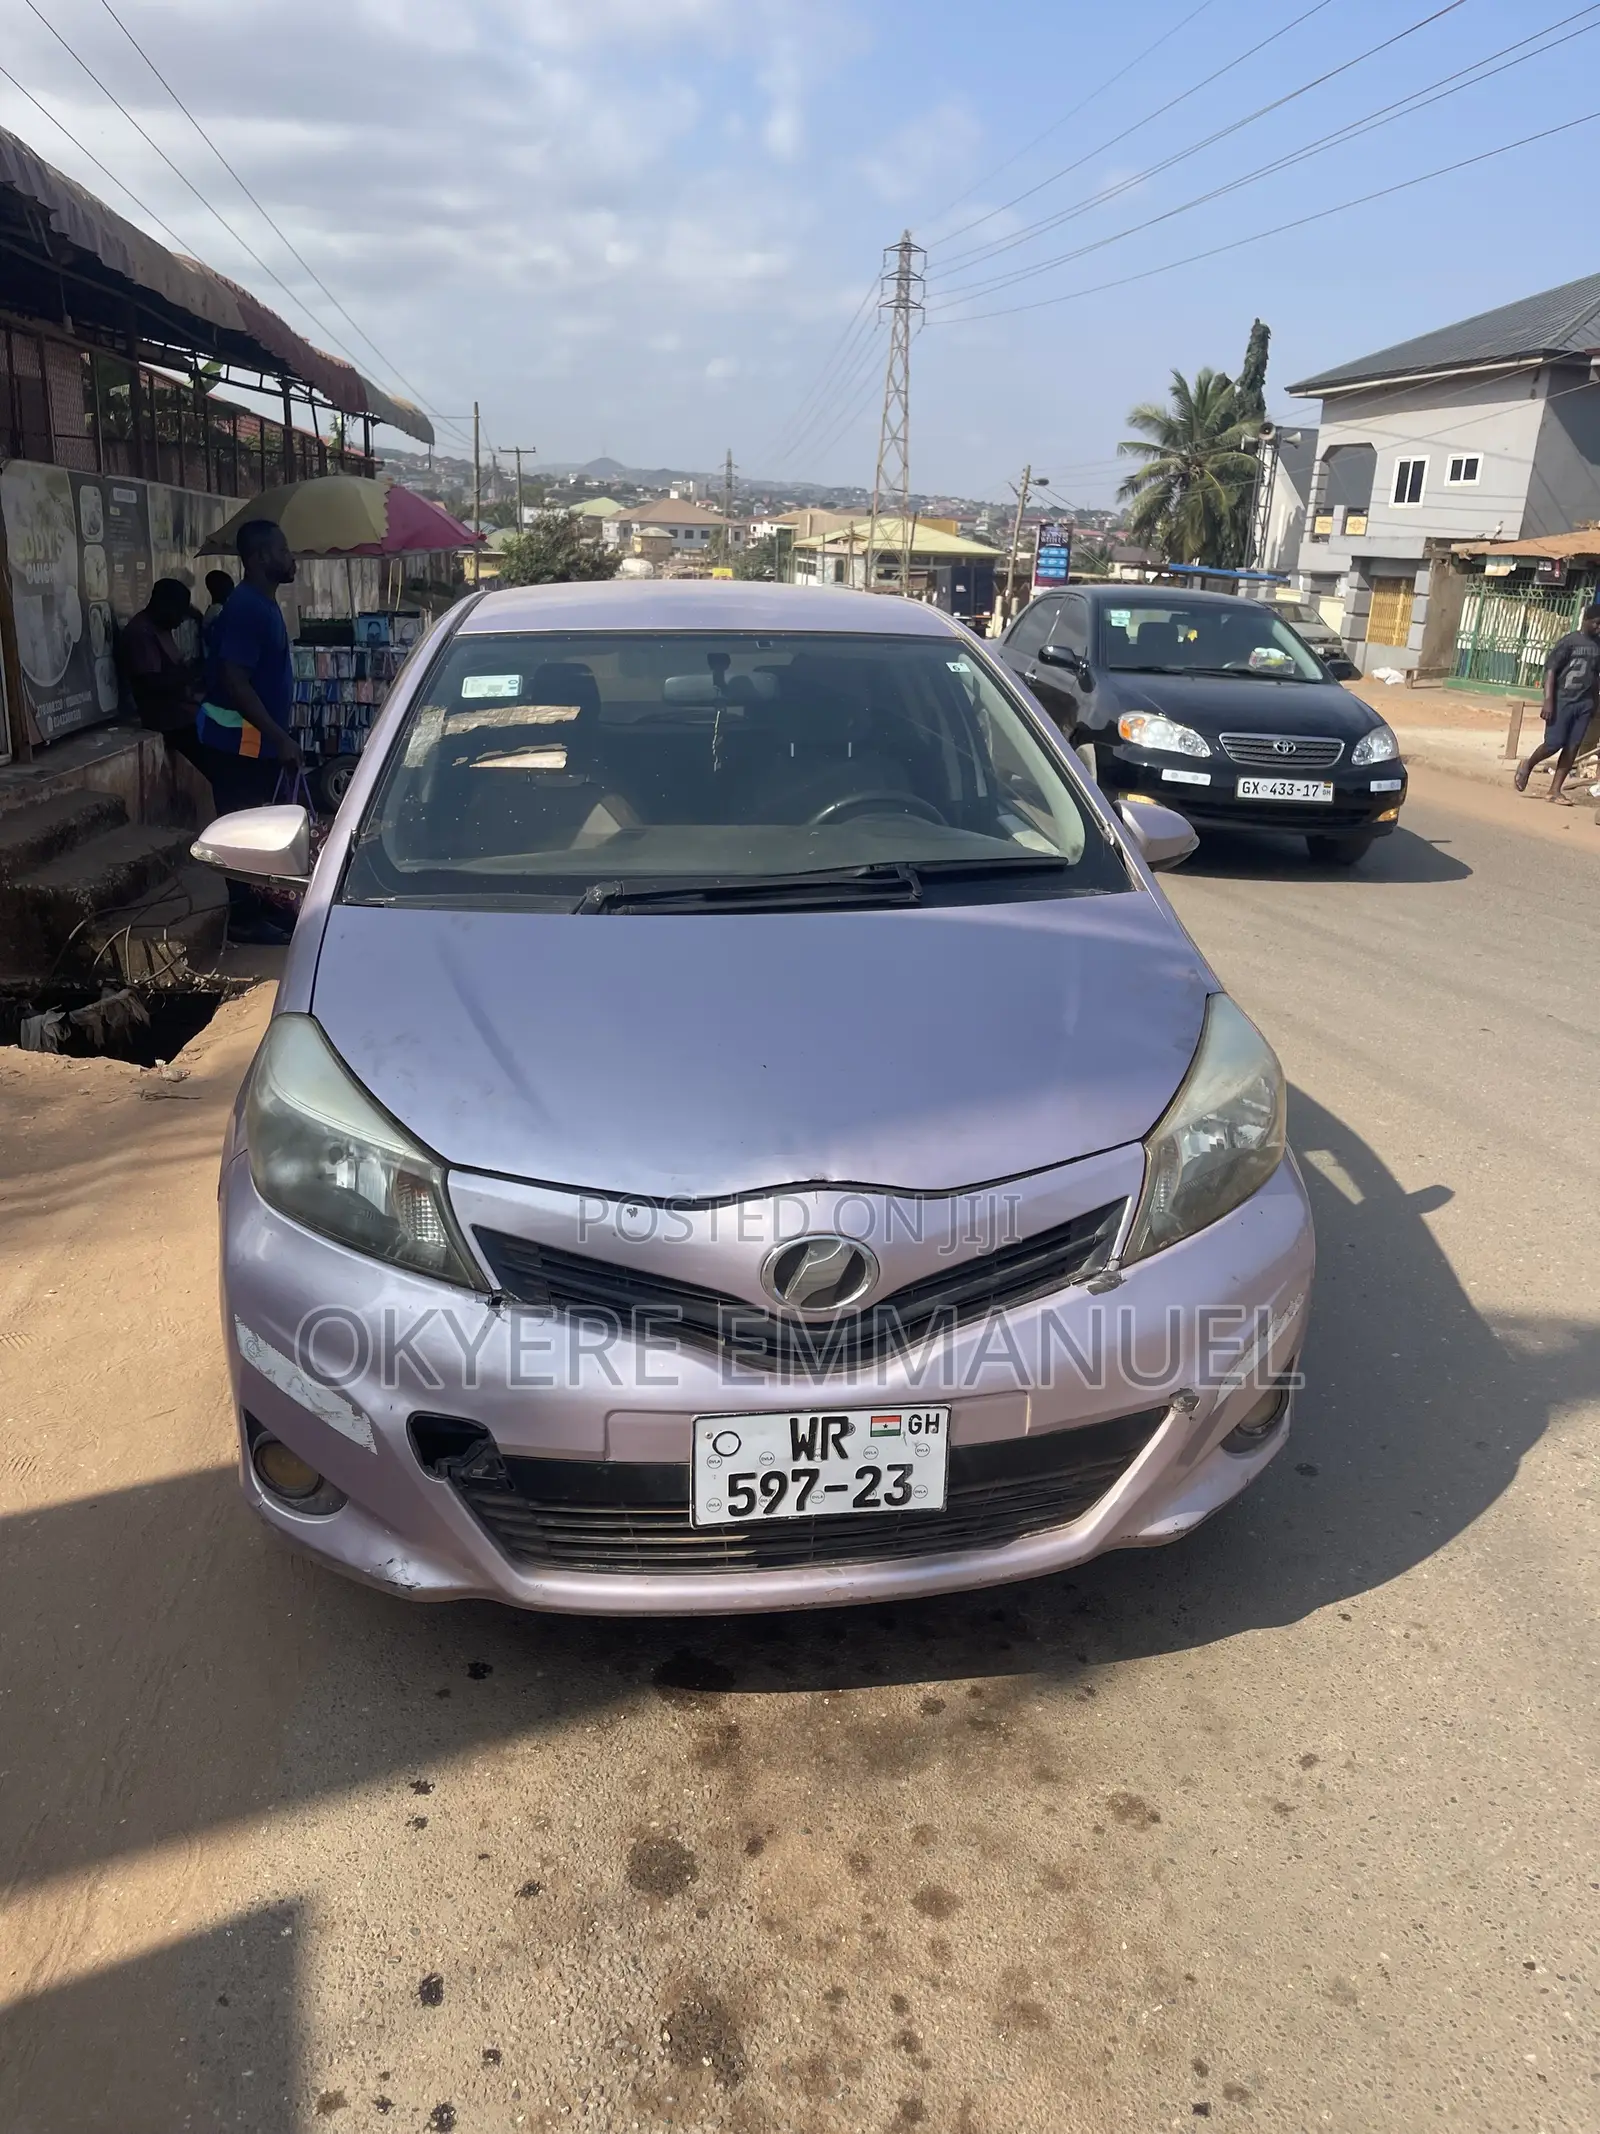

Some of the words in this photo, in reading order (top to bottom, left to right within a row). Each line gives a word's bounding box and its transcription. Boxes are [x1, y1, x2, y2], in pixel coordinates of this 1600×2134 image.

[1564, 657, 1588, 690] 2
[1242, 781, 1260, 795] GX
[1269, 782, 1319, 797] 433-17
[790, 1416, 849, 1462] WR
[907, 1413, 940, 1436] GH
[727, 1463, 913, 1517] 597-23
